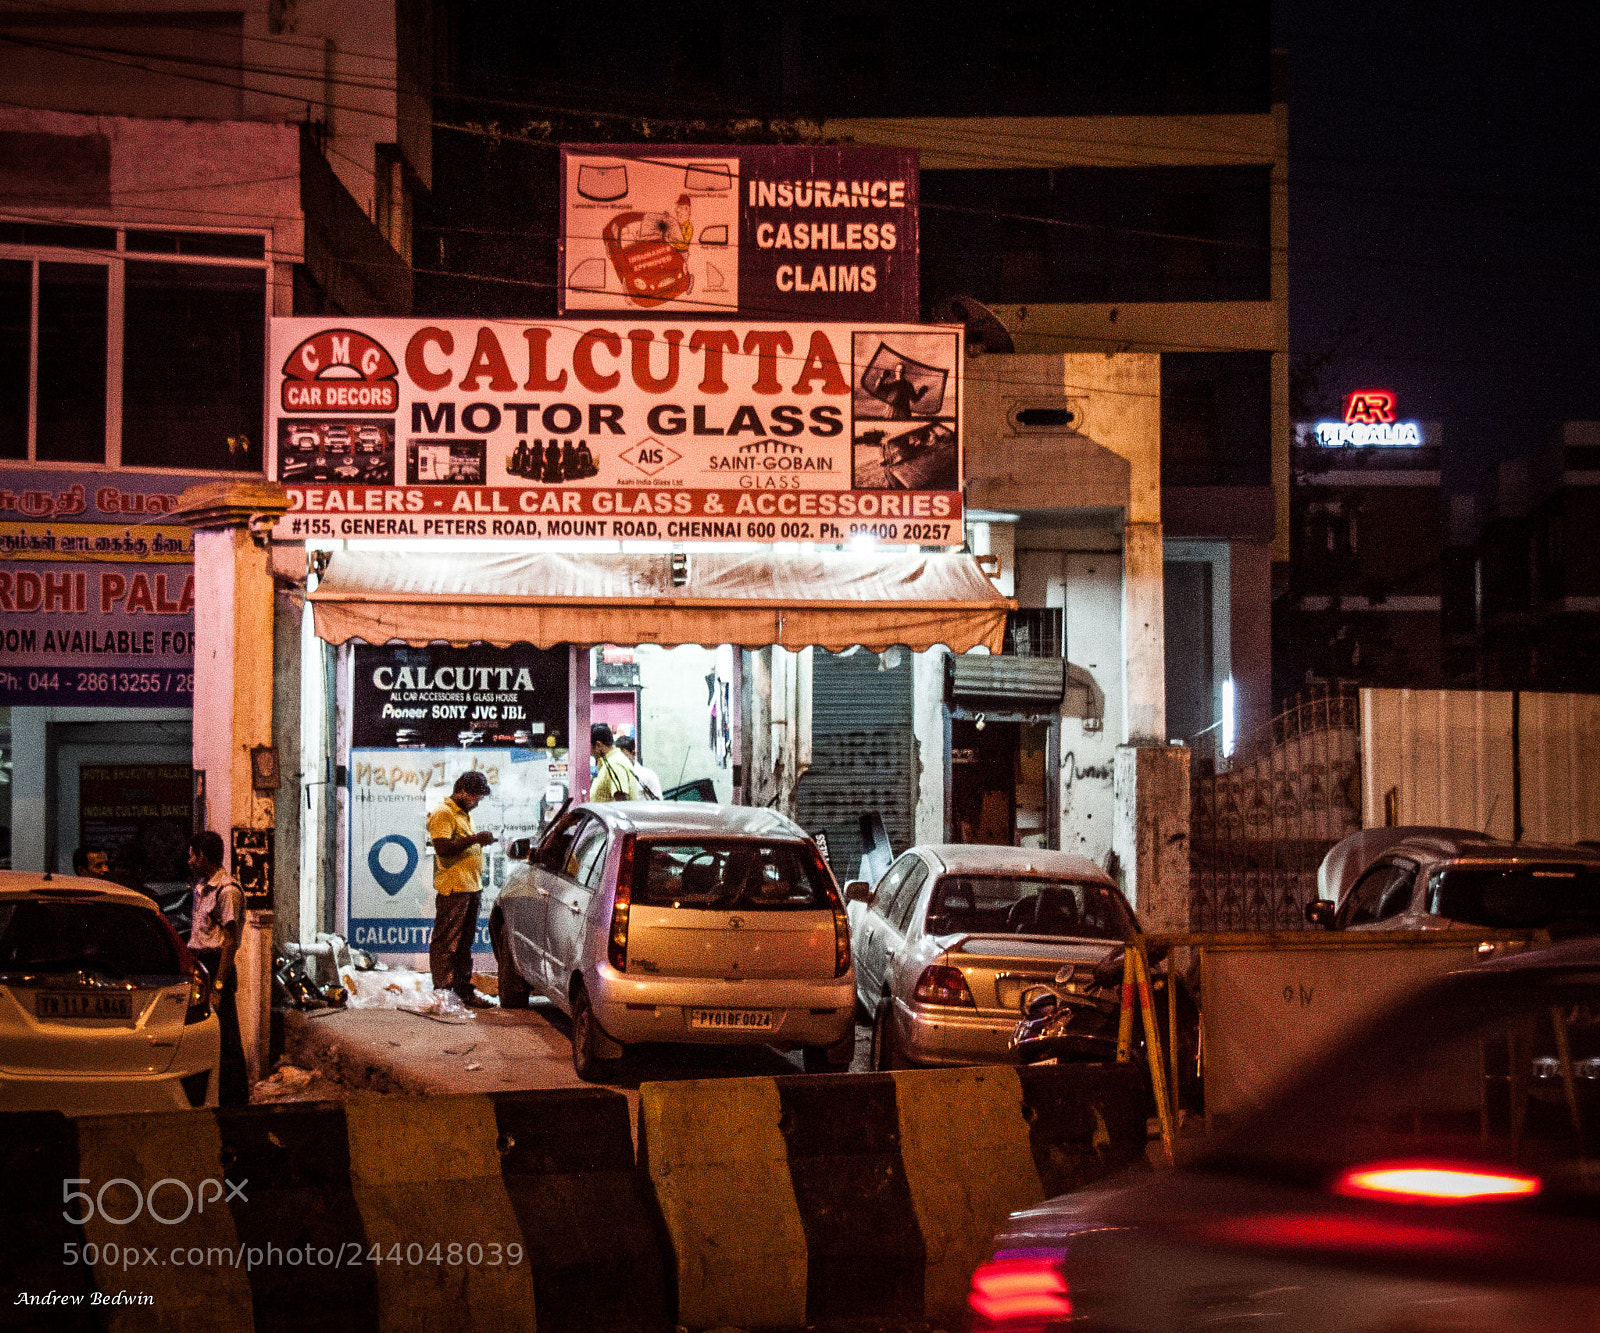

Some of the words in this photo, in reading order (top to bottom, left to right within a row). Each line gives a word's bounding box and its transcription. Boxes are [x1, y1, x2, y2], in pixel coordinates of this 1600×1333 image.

[748, 180, 906, 208] INSURANCE
[756, 222, 897, 251] CASHLESS
[775, 264, 877, 292] CLAIMS
[404, 326, 851, 396] CALCUTTA
[288, 387, 322, 405] CAR
[326, 387, 392, 406] DECORS
[1344, 392, 1397, 423] AR
[411, 402, 625, 435] MOTOR
[646, 404, 844, 437] GLASS
[638, 449, 663, 464] AIS
[709, 456, 833, 470] SAINT-GOBAIN
[738, 475, 801, 489] GLASS
[286, 490, 424, 512] DEALERS
[452, 491, 509, 512] ALL
[519, 491, 581, 513] CAR
[591, 492, 692, 514] GLASS
[703, 494, 724, 514] &
[735, 494, 951, 516] ACCESSORIES
[292, 519, 336, 538] #155,
[341, 519, 418, 535] GENERAL
[423, 520, 487, 536] PETERS
[492, 520, 542, 538] ROAD,
[547, 521, 605, 536] MOUNT
[613, 521, 662, 539] ROAD,
[667, 522, 742, 538] CHENNAI
[748, 522, 775, 538] 600
[781, 522, 814, 539] 002.
[820, 522, 844, 538] Ph.
[903, 523, 951, 540] 20257
[43, 629, 155, 655] AVAILABLE
[28, 672, 59, 692] 044
[77, 672, 161, 693] 28613255
[372, 666, 535, 692] CALCUTTA
[390, 692, 402, 701] ALL
[403, 692, 418, 702] CAR
[419, 692, 464, 702] ACCESSORIES
[472, 692, 495, 702] GLASS
[496, 693, 518, 703] HOUSE
[432, 705, 468, 719] SONY
[472, 705, 498, 720] JVC
[501, 705, 527, 720] JBL
[377, 794, 427, 803] EVERYTHIN
